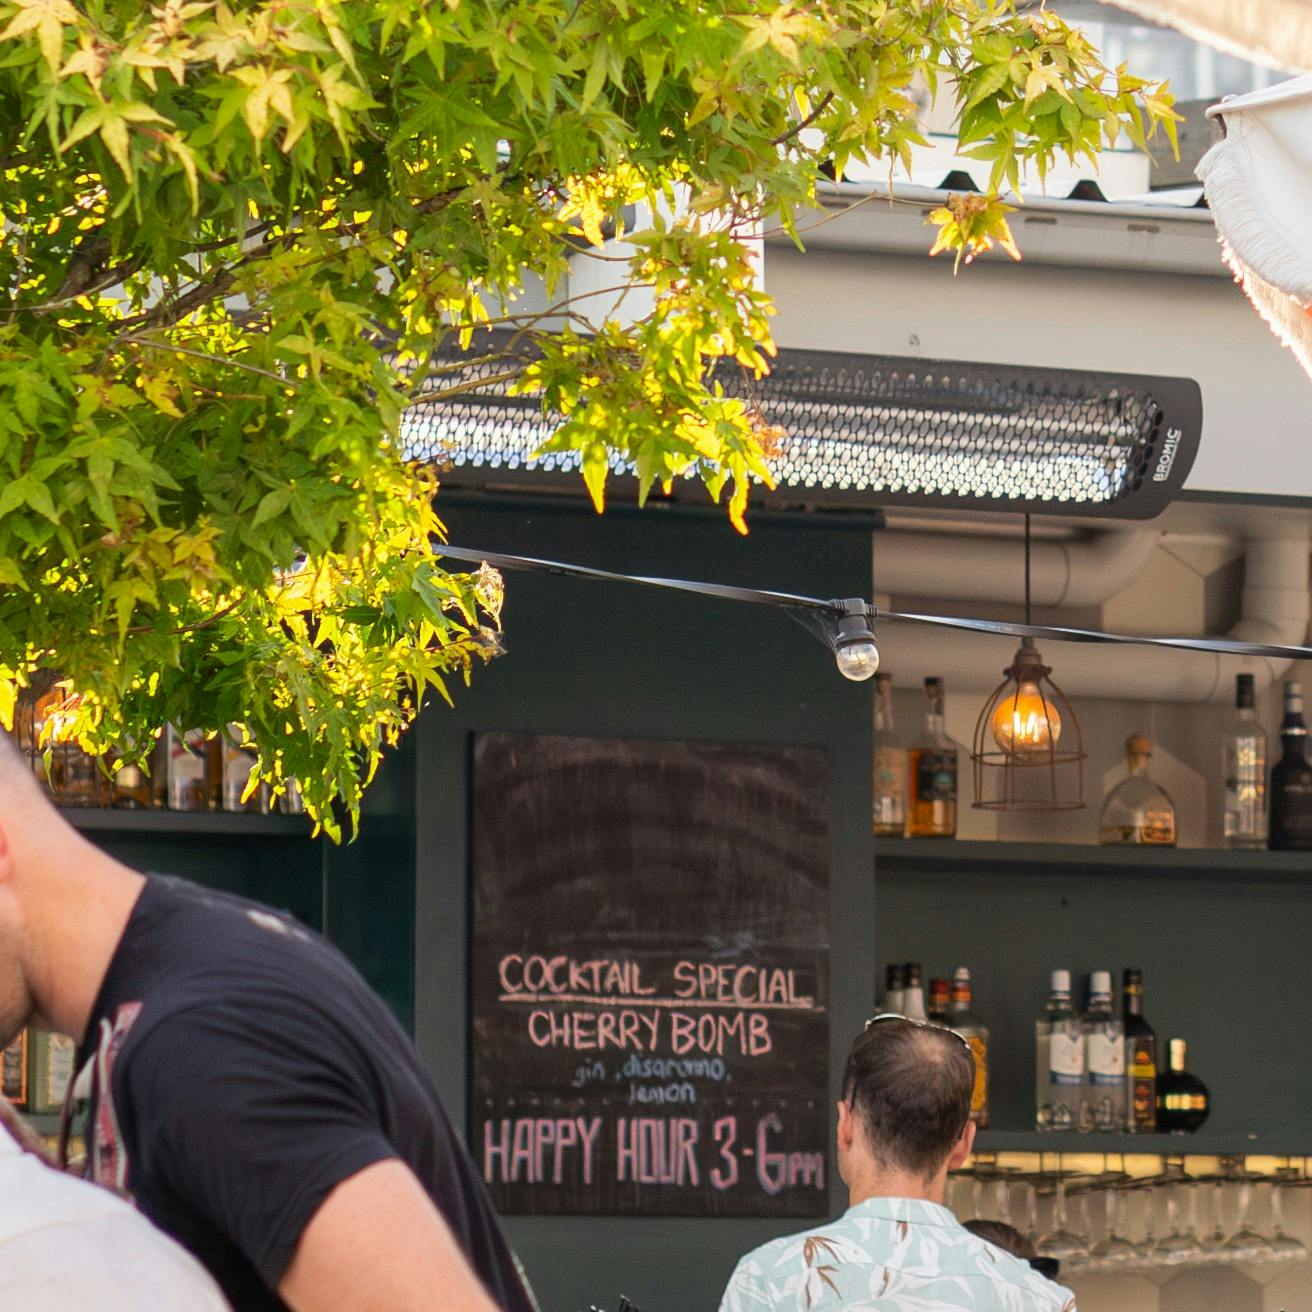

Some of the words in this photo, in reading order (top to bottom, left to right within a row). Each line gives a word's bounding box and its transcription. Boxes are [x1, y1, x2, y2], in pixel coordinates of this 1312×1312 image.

[1152, 427, 1180, 482] BROMIC
[498, 954, 657, 994] COCKTAIL
[673, 960, 814, 1006] SPECIAL
[528, 1008, 661, 1052] CHERRY
[671, 1011, 772, 1057] BOMB
[627, 1082, 696, 1106] lemon
[484, 1116, 602, 1185] HAPPY
[616, 1118, 699, 1186] HOUR
